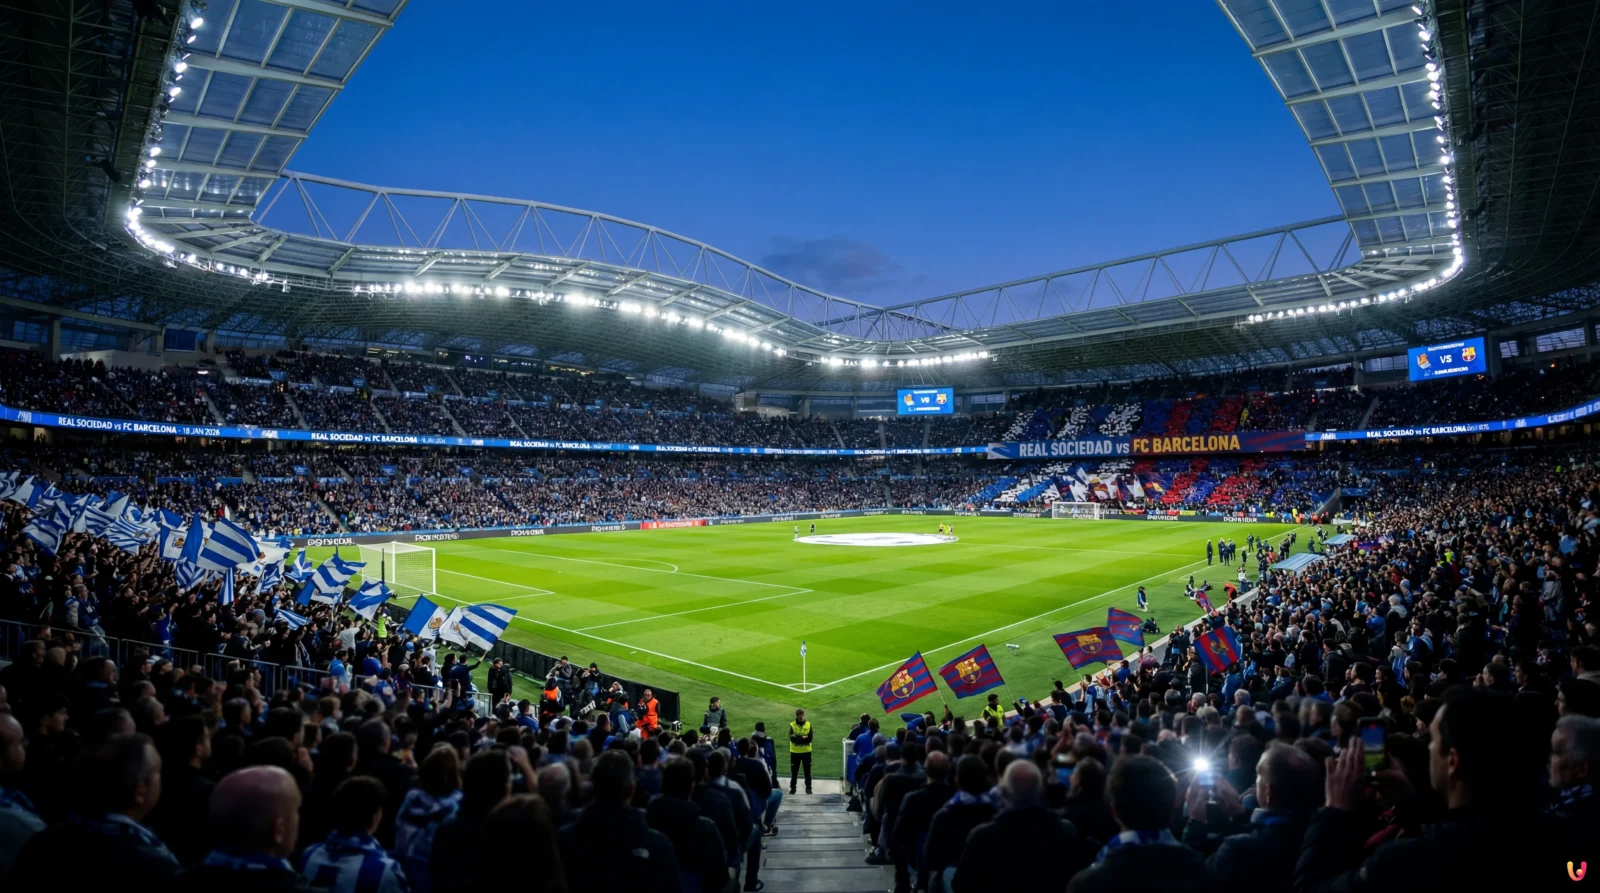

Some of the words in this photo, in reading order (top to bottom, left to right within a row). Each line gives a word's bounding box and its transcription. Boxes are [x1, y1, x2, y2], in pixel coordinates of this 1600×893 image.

[1439, 354, 1452, 364] VS
[58, 417, 75, 427] REAL
[76, 418, 112, 430] SOCIEDAD
[123, 422, 132, 431] FC
[133, 423, 177, 434] BARCELONA
[204, 428, 220, 436] 2026
[1383, 429, 1414, 437] SOCIEDAD
[1431, 425, 1467, 434] BARCELONA
[311, 432, 329, 440] REAL
[330, 433, 363, 441] SOCIEDAD
[1019, 442, 1048, 458] REAL
[1050, 440, 1112, 456] SOCIEDAD
[1116, 442, 1129, 454] VS
[1133, 438, 1149, 453] FC
[1152, 434, 1240, 452] BARCELONA
